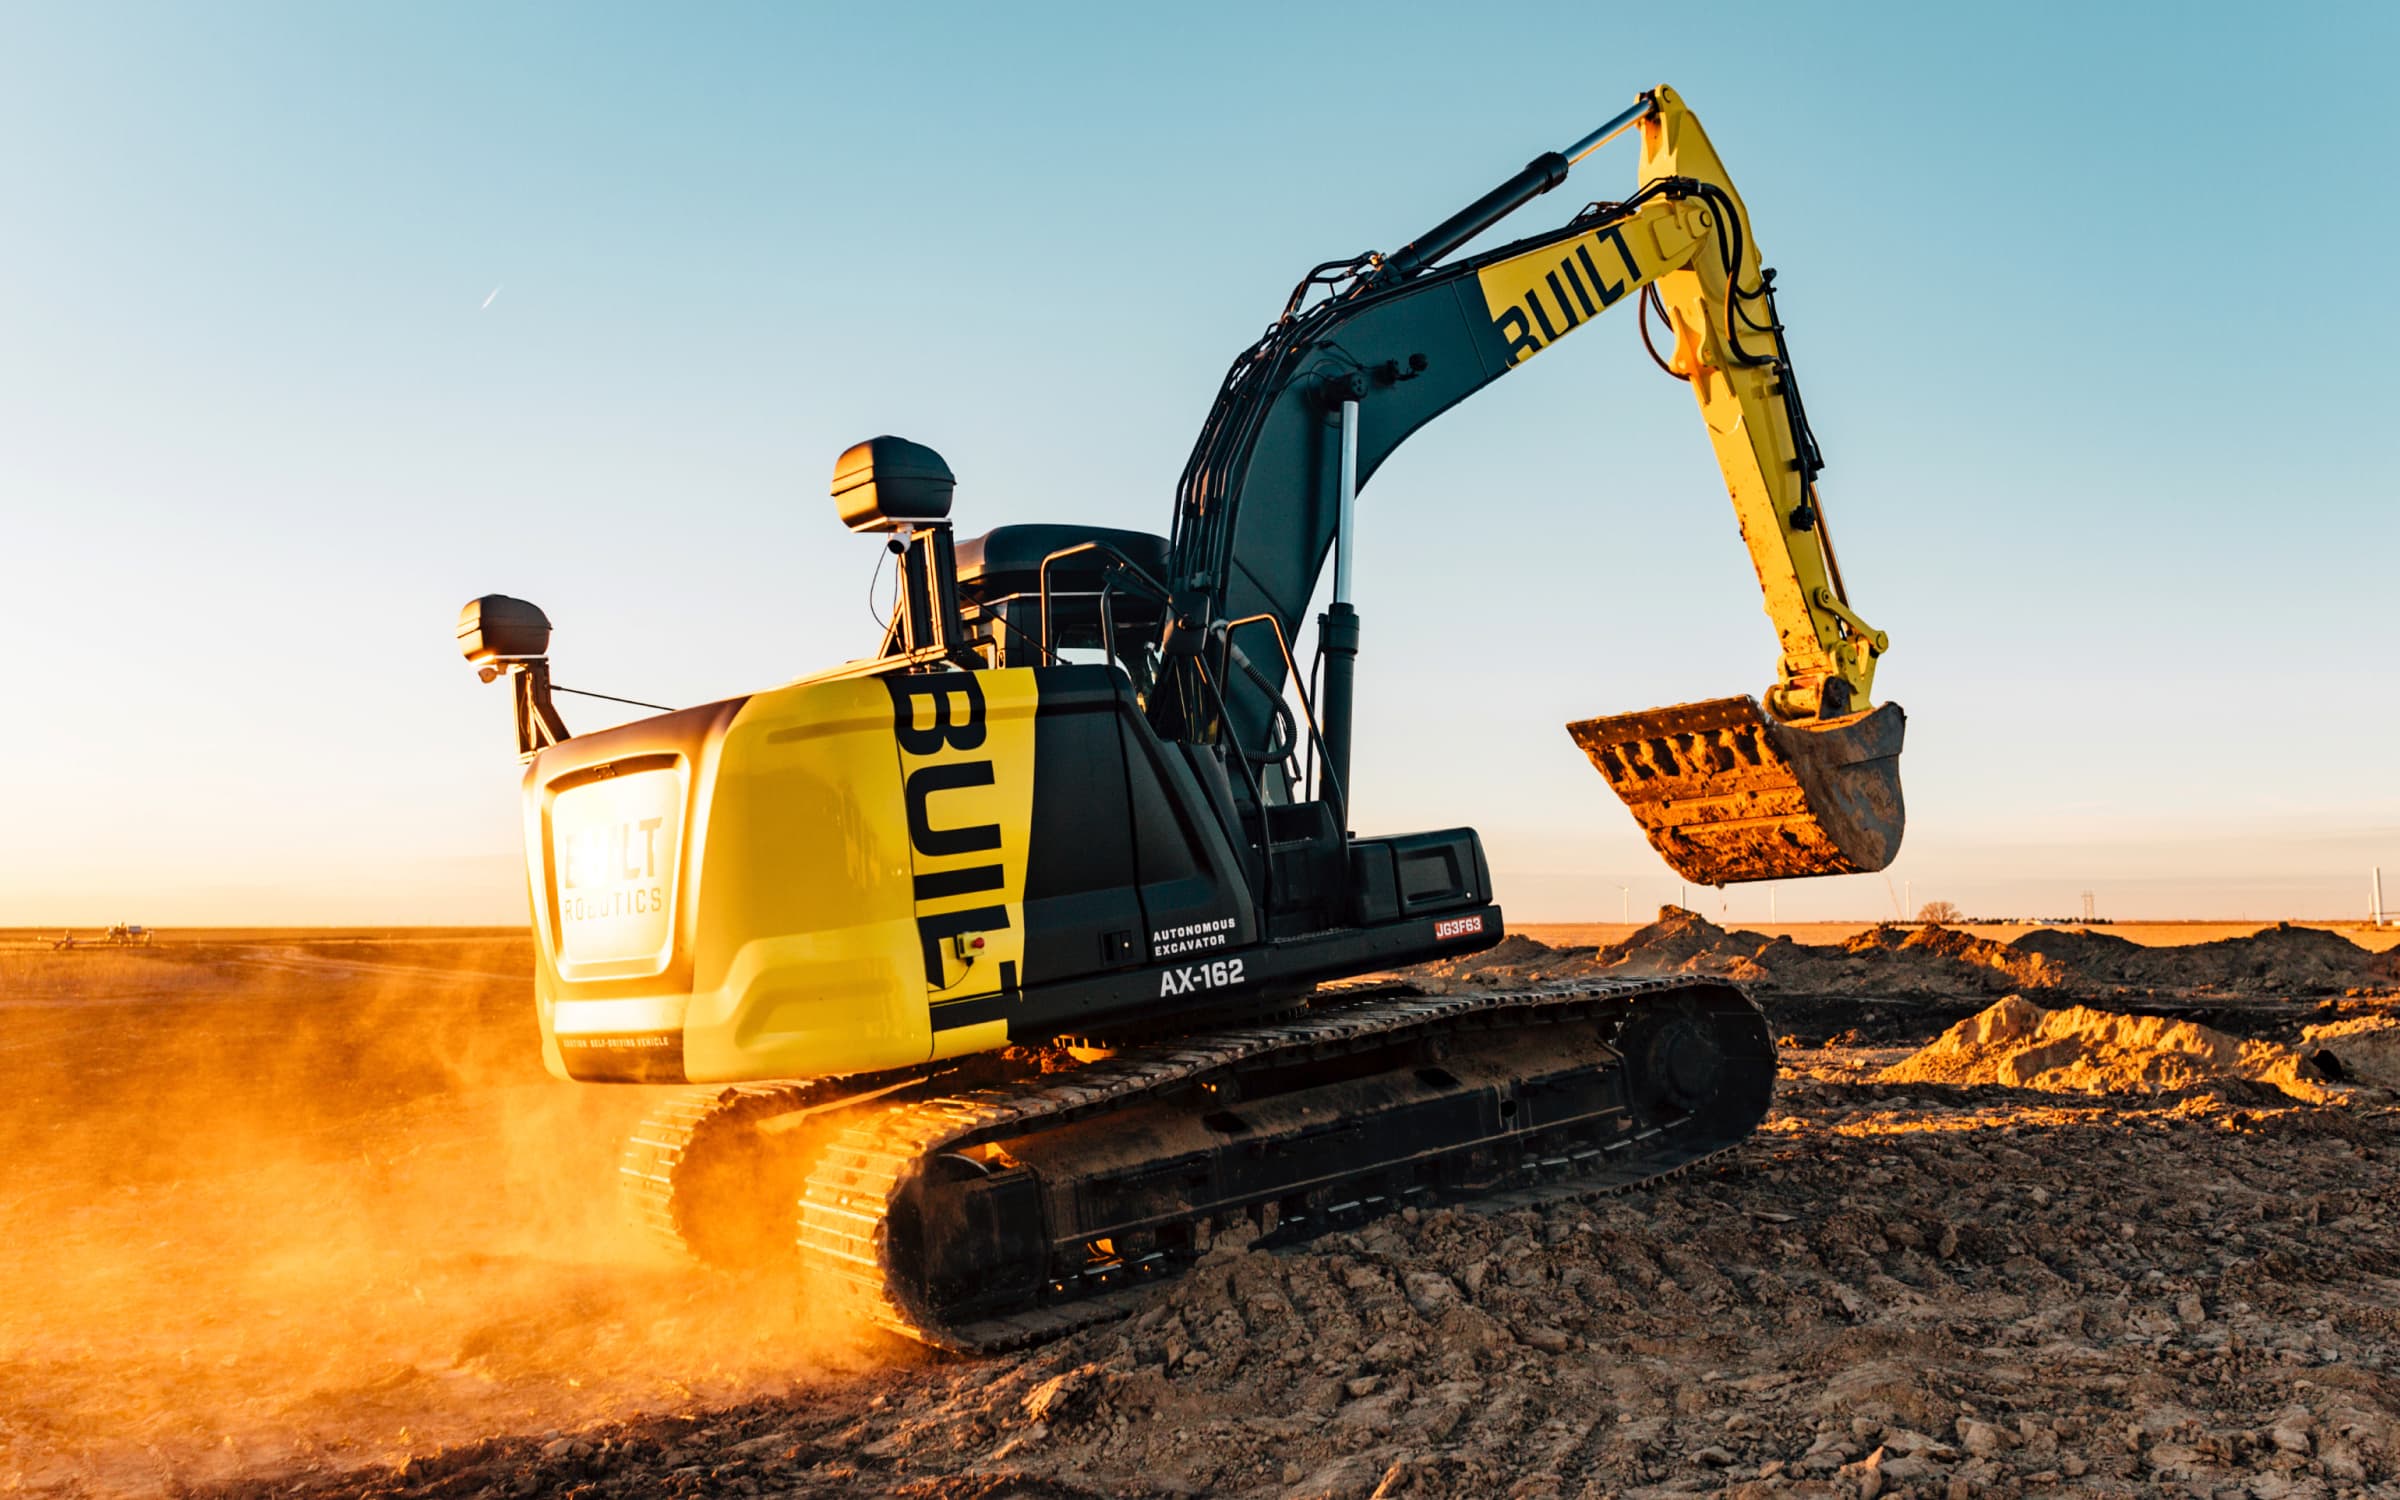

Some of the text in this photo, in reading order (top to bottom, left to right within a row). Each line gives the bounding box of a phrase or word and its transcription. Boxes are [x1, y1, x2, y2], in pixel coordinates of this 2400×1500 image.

[564, 816, 663, 889] BLT
[885, 671, 1017, 1034] BUILT
[1153, 918, 1236, 942] AUTONOMOUS
[1436, 917, 1481, 937] JG3F63
[1154, 934, 1226, 957] EXCAVATOR
[1160, 958, 1245, 998] AX-162
[637, 1036, 669, 1048] VEHICLE
